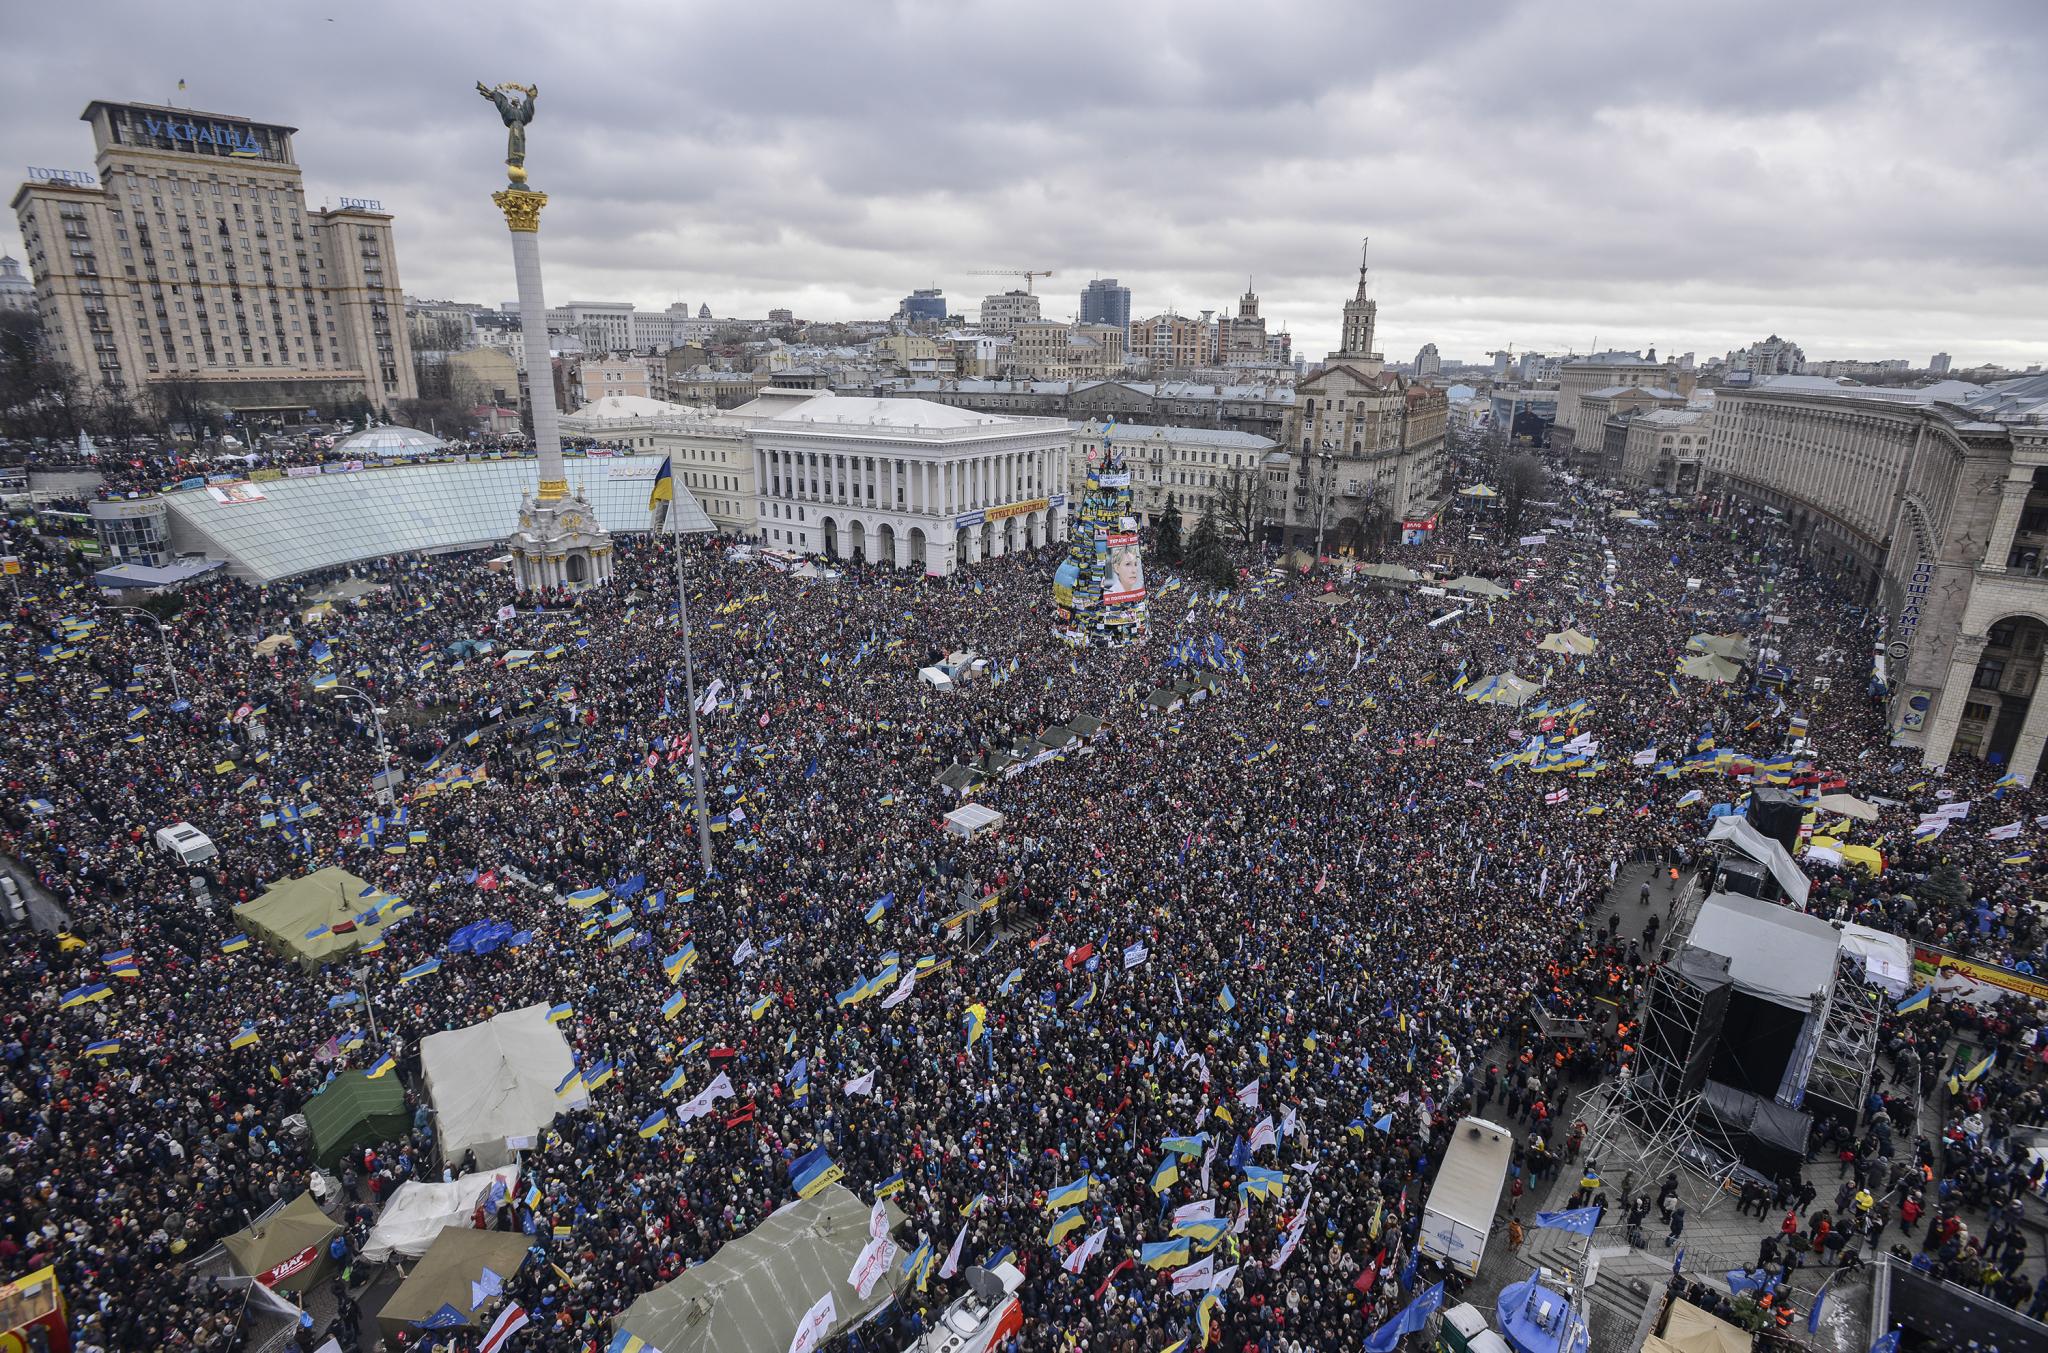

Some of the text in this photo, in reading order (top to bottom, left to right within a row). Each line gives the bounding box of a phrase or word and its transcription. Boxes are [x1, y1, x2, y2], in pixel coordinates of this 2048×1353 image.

[144, 118, 259, 149] УКРАЇНА
[27, 166, 95, 184] ГОТЕЛЬ
[340, 197, 384, 210] HOTEL
[1898, 563, 1932, 636] ПОШТАМТ
[272, 1254, 304, 1277] УДАР
